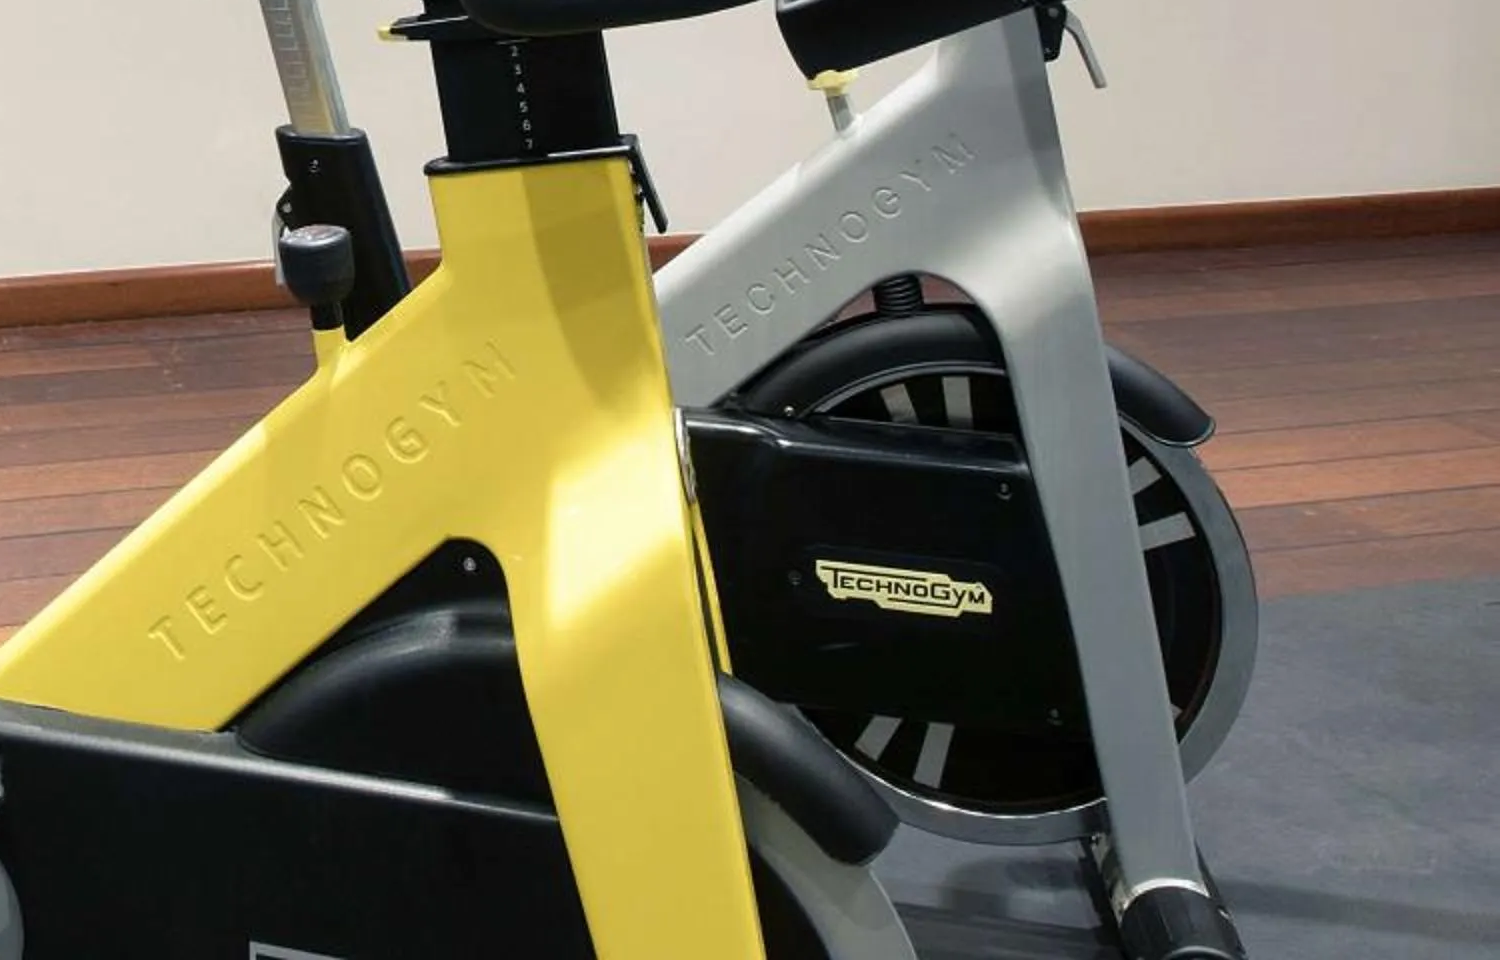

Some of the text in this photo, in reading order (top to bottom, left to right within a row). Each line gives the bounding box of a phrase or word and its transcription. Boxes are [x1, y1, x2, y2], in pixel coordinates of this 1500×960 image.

[684, 132, 979, 356] TECHNOGYM
[147, 337, 518, 661] TECHNOGYM
[820, 565, 986, 609] TECHNOGYM
